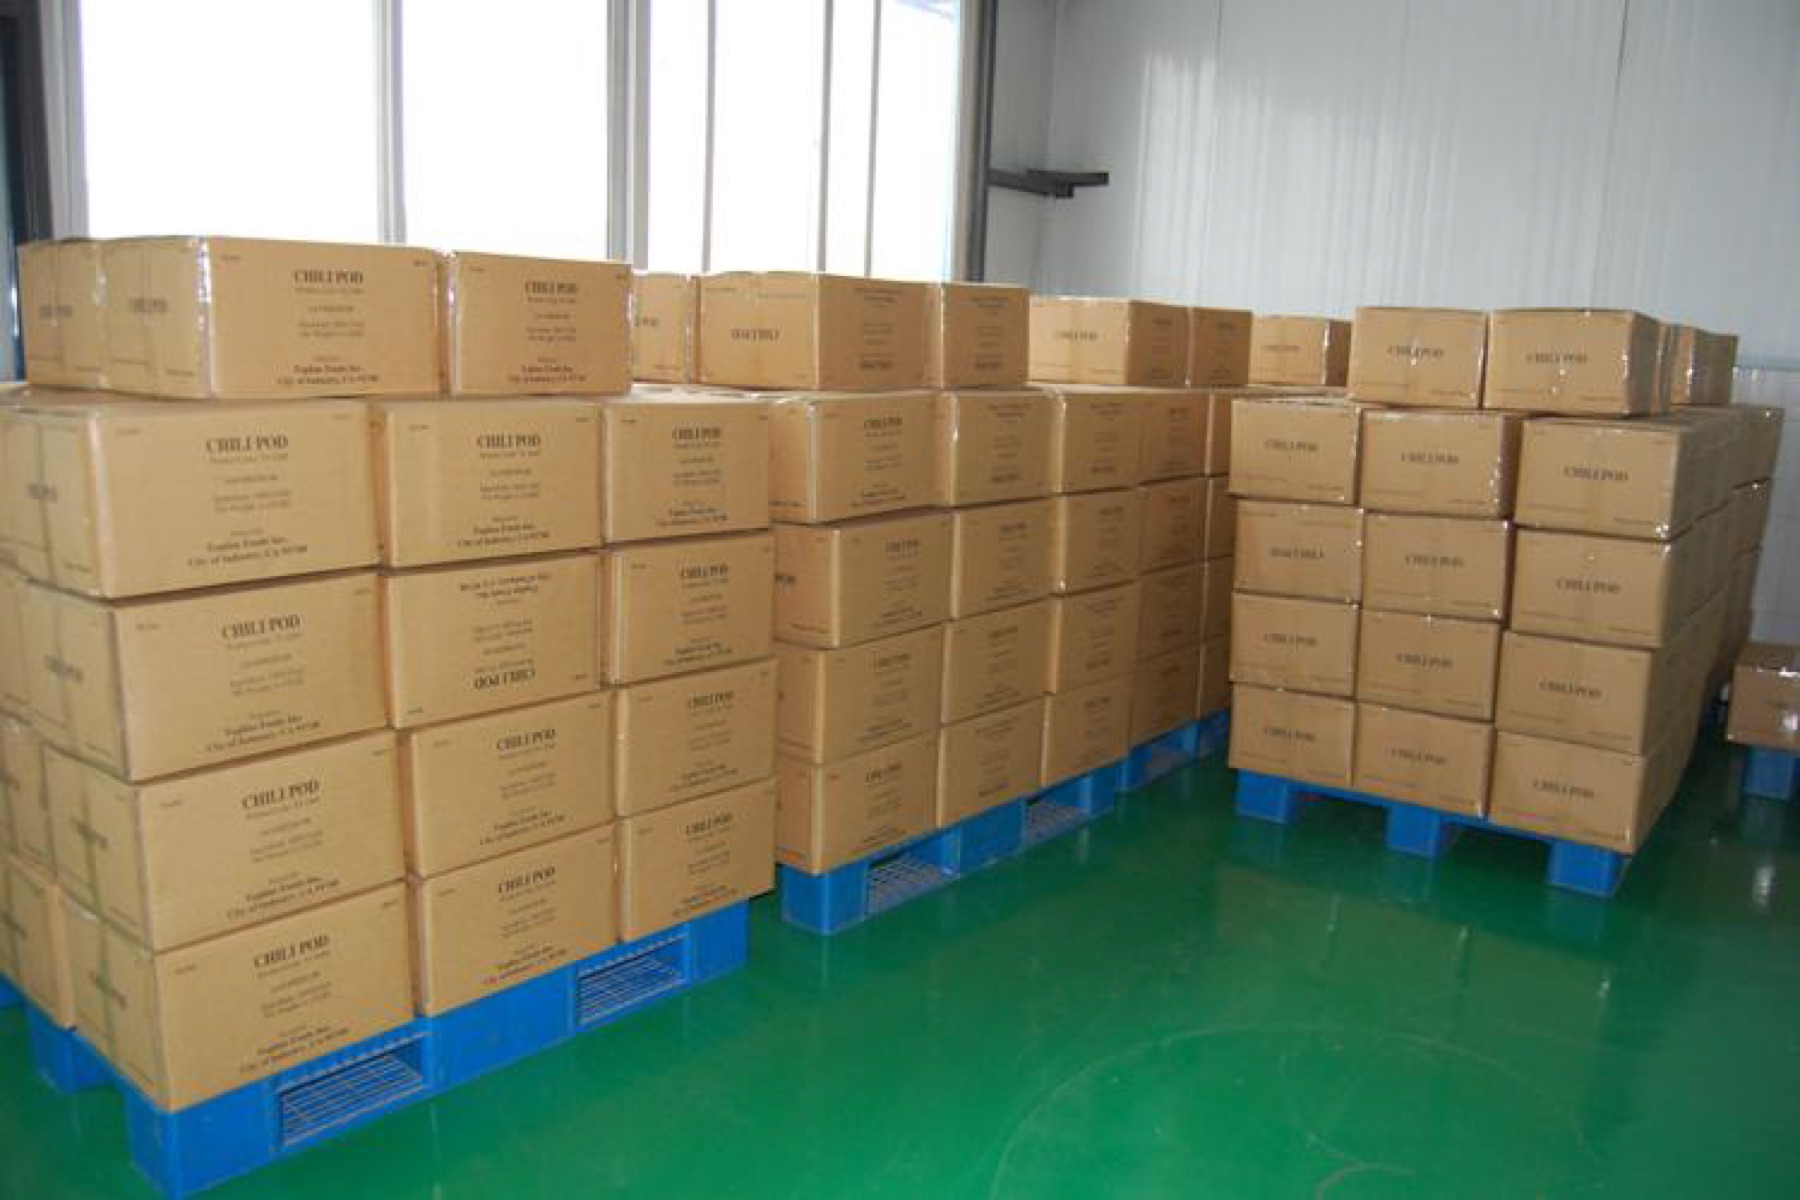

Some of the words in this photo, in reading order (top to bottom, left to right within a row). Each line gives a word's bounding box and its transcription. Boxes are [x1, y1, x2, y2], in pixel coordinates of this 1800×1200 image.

[293, 268, 333, 284] CHILI
[335, 269, 364, 284] POD
[524, 280, 555, 294] CHILI
[556, 281, 578, 294] POD
[205, 437, 252, 453] CHILI
[256, 434, 288, 451] POD
[476, 434, 514, 449] CHILI
[515, 434, 542, 448] POD
[222, 618, 265, 639] CHILI
[268, 614, 301, 631] POD
[531, 728, 556, 744] POD
[242, 787, 285, 809] CHILI
[288, 779, 321, 798] POD
[254, 944, 296, 968] CHILI
[299, 933, 330, 955] POD
